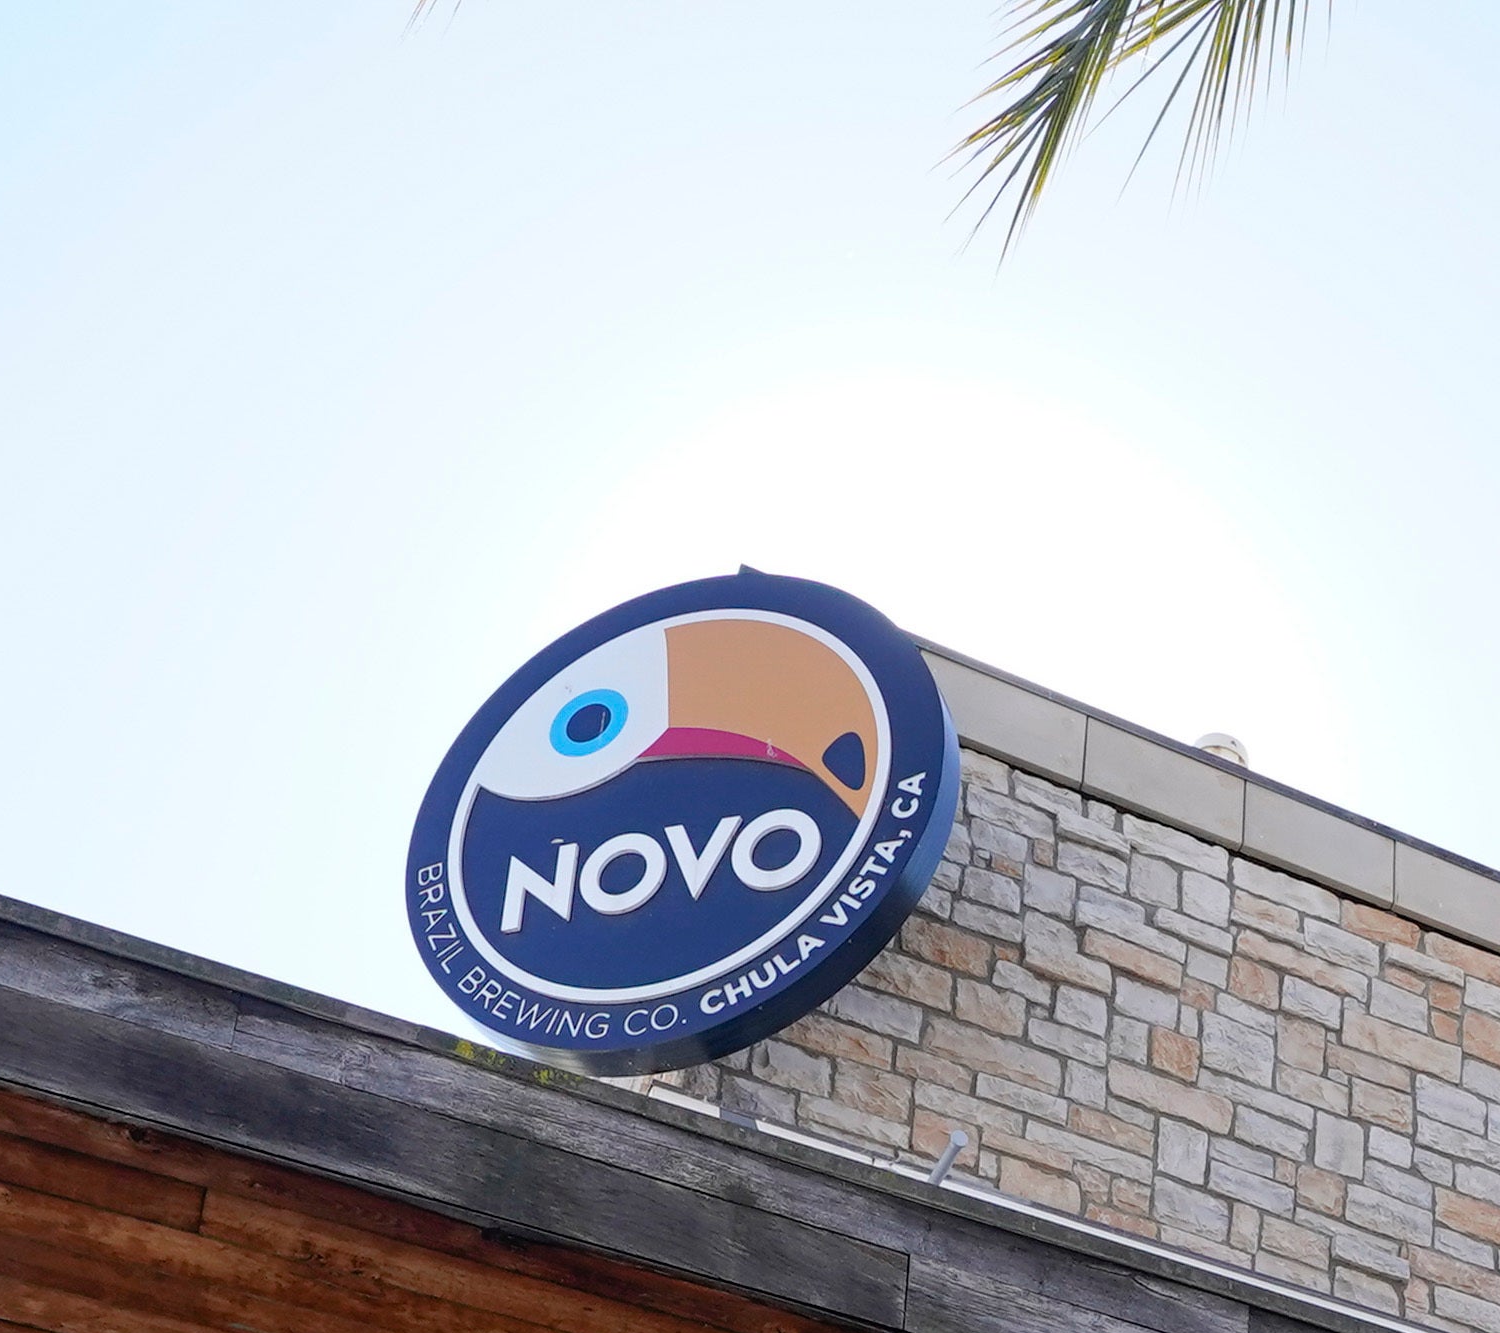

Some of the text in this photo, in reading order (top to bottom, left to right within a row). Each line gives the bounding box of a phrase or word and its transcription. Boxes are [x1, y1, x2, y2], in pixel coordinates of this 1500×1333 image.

[418, 771, 927, 1039] BRAZIL BREWING CO. CHULA VISTA, CA
[501, 808, 822, 934] NOVO
